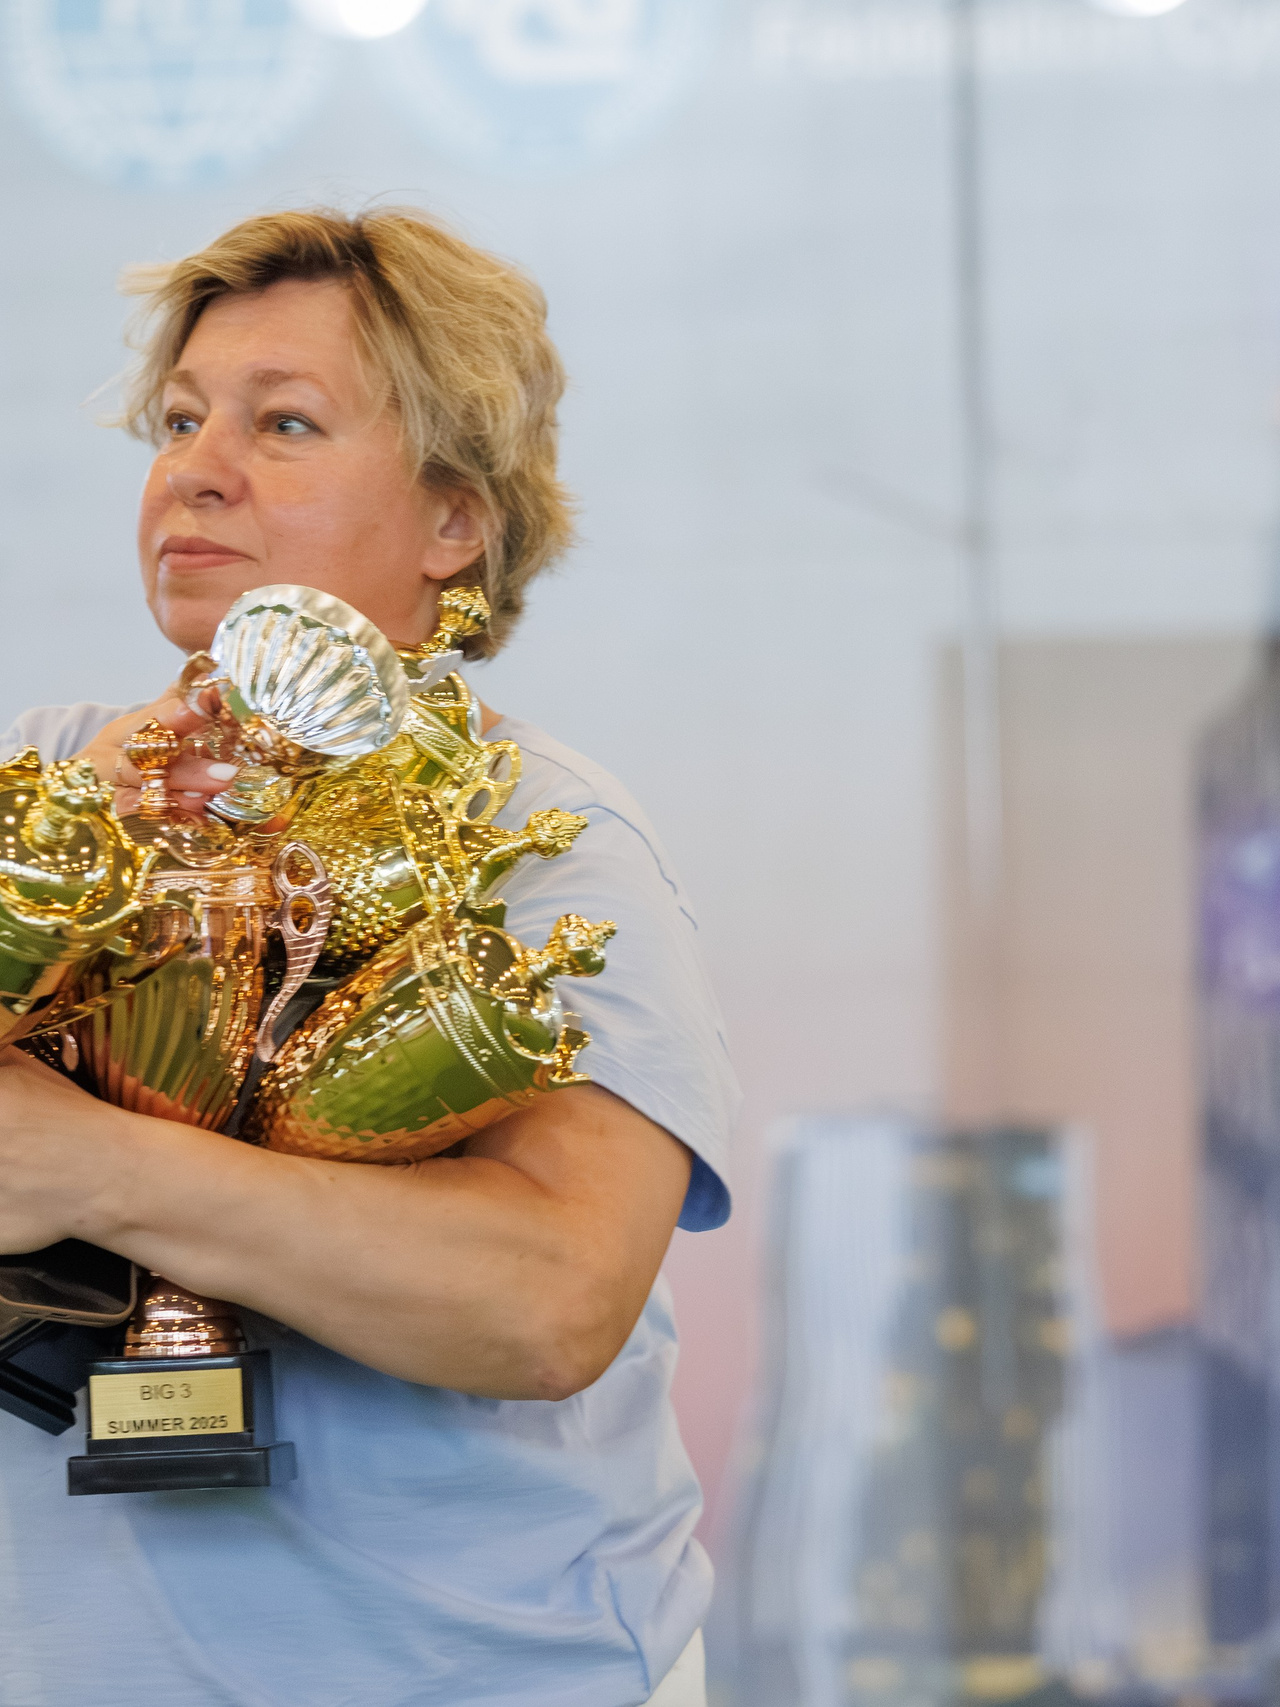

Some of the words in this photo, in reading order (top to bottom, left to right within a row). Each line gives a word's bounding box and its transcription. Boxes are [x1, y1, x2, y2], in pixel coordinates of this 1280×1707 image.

[139, 1383, 176, 1401] BIG
[180, 1382, 193, 1399] 3
[107, 1417, 185, 1434] SUMMER
[189, 1415, 229, 1431] 2025
